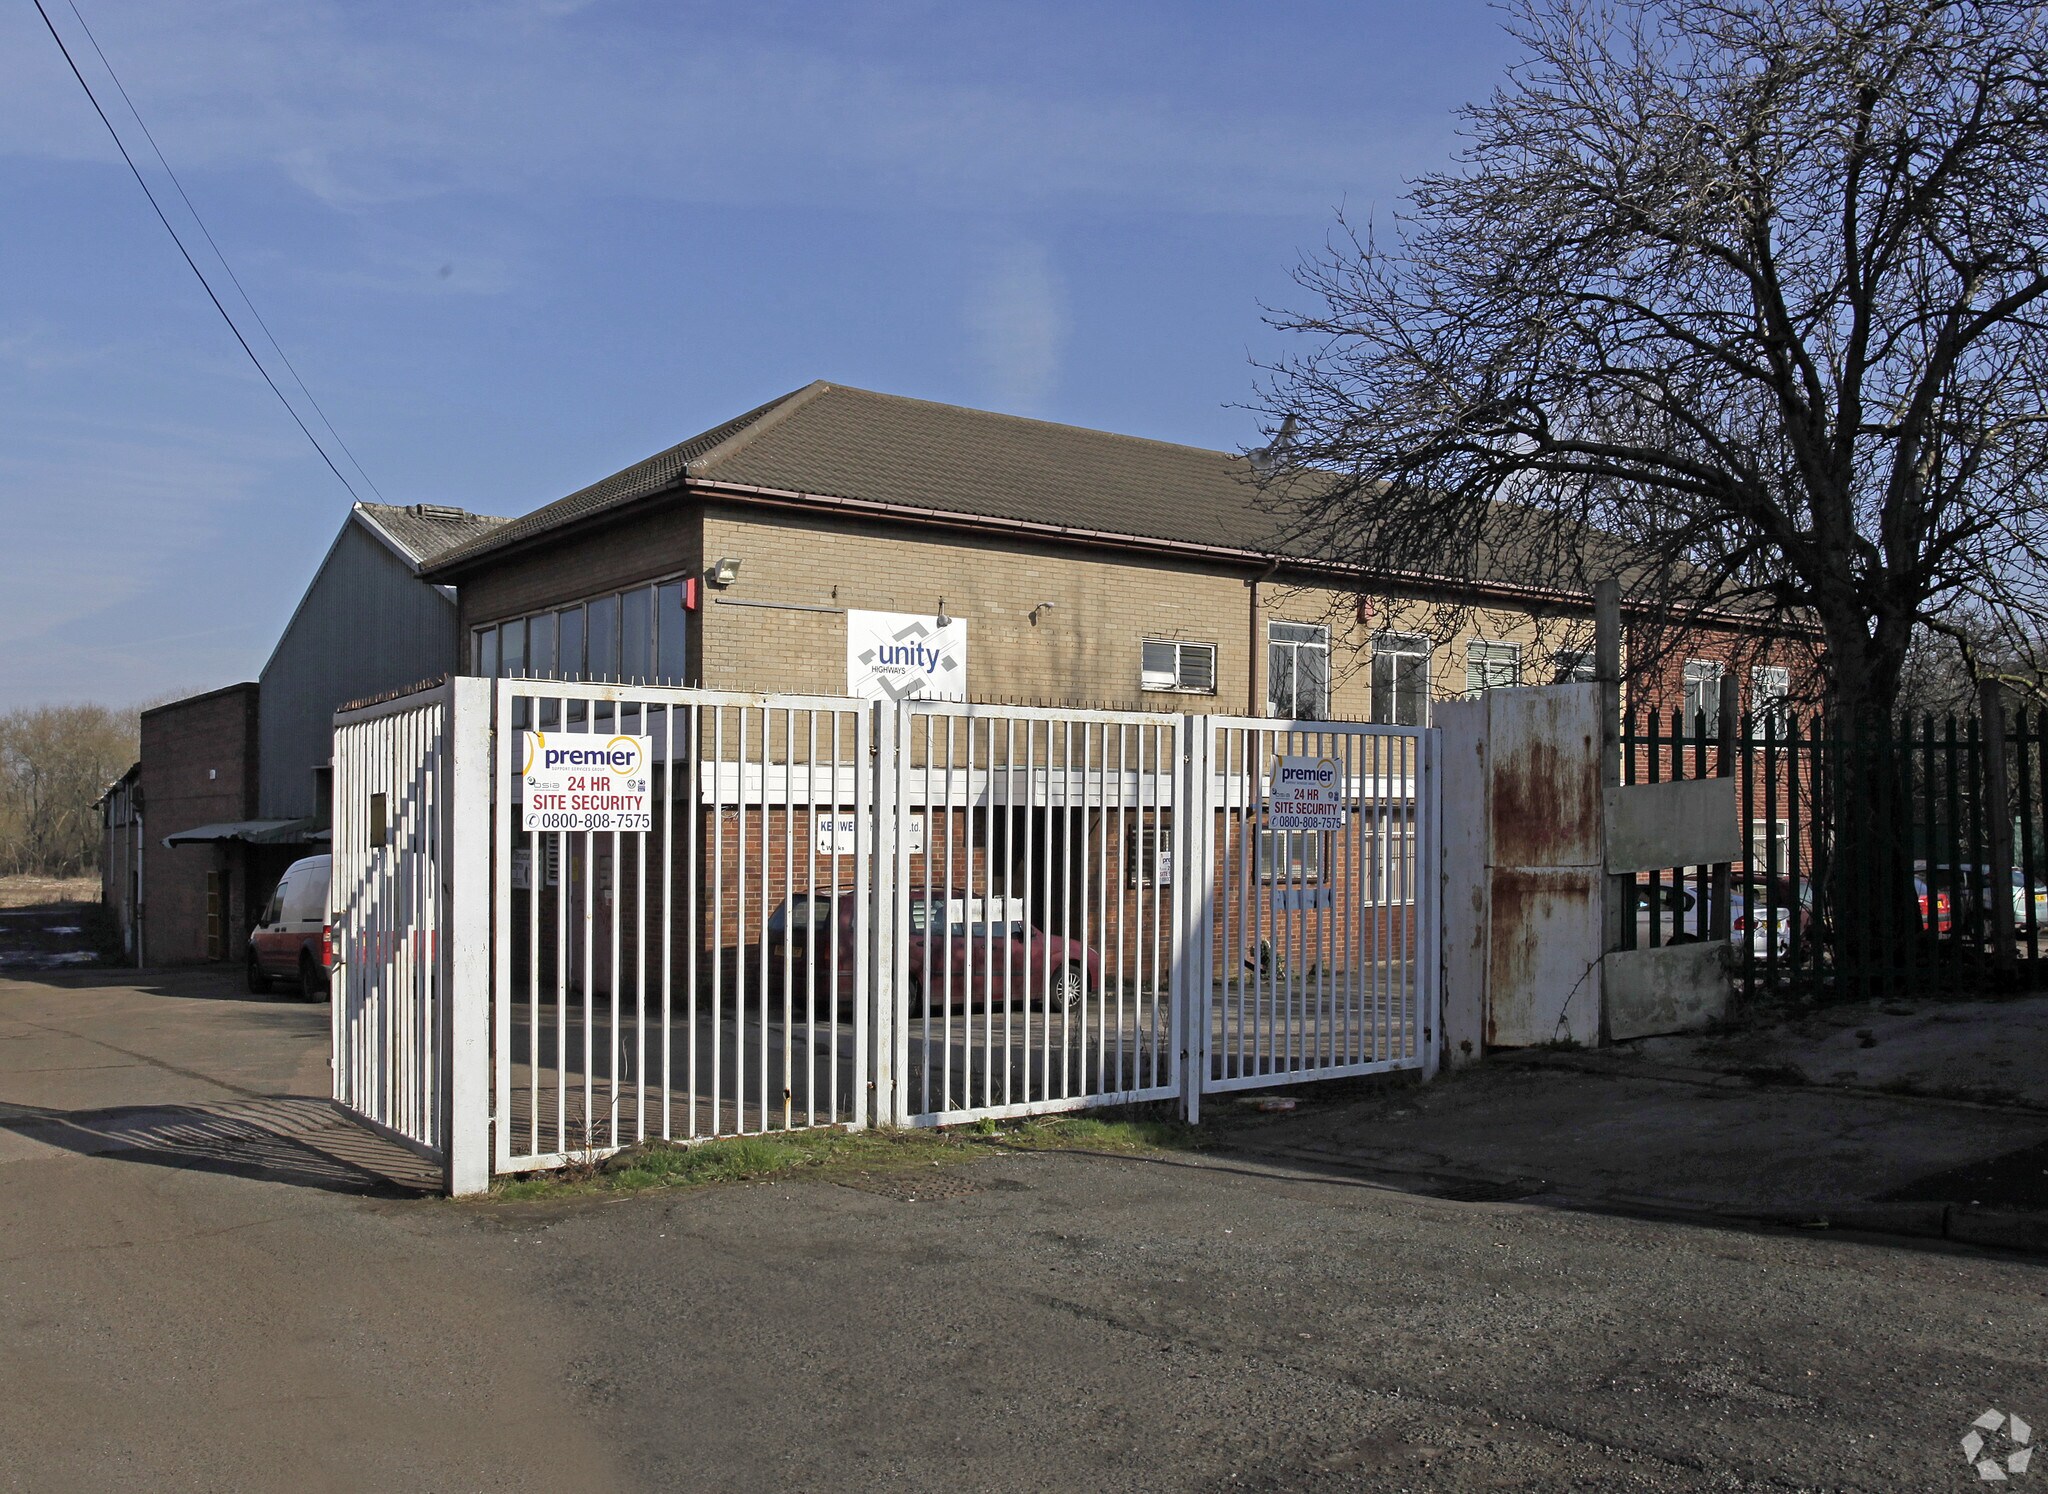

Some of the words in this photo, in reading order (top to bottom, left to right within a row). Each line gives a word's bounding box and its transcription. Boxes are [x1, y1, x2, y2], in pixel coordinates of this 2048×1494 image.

[879, 640, 940, 673] unity
[871, 666, 906, 675] HIGHWAYS
[545, 749, 636, 769] premier
[1282, 767, 1333, 783] premier
[567, 776, 585, 791] 24
[590, 776, 610, 791] HR
[1294, 788, 1304, 800] 24
[1307, 788, 1319, 801] HR
[533, 794, 566, 810] SITE
[571, 795, 643, 811] SECURITY
[1274, 801, 1293, 814] SITE
[1296, 802, 1338, 815] SECURITY
[542, 813, 650, 828] 0800-808-7575
[909, 822, 921, 832] td.
[1279, 815, 1341, 829] 0800-808-7575
